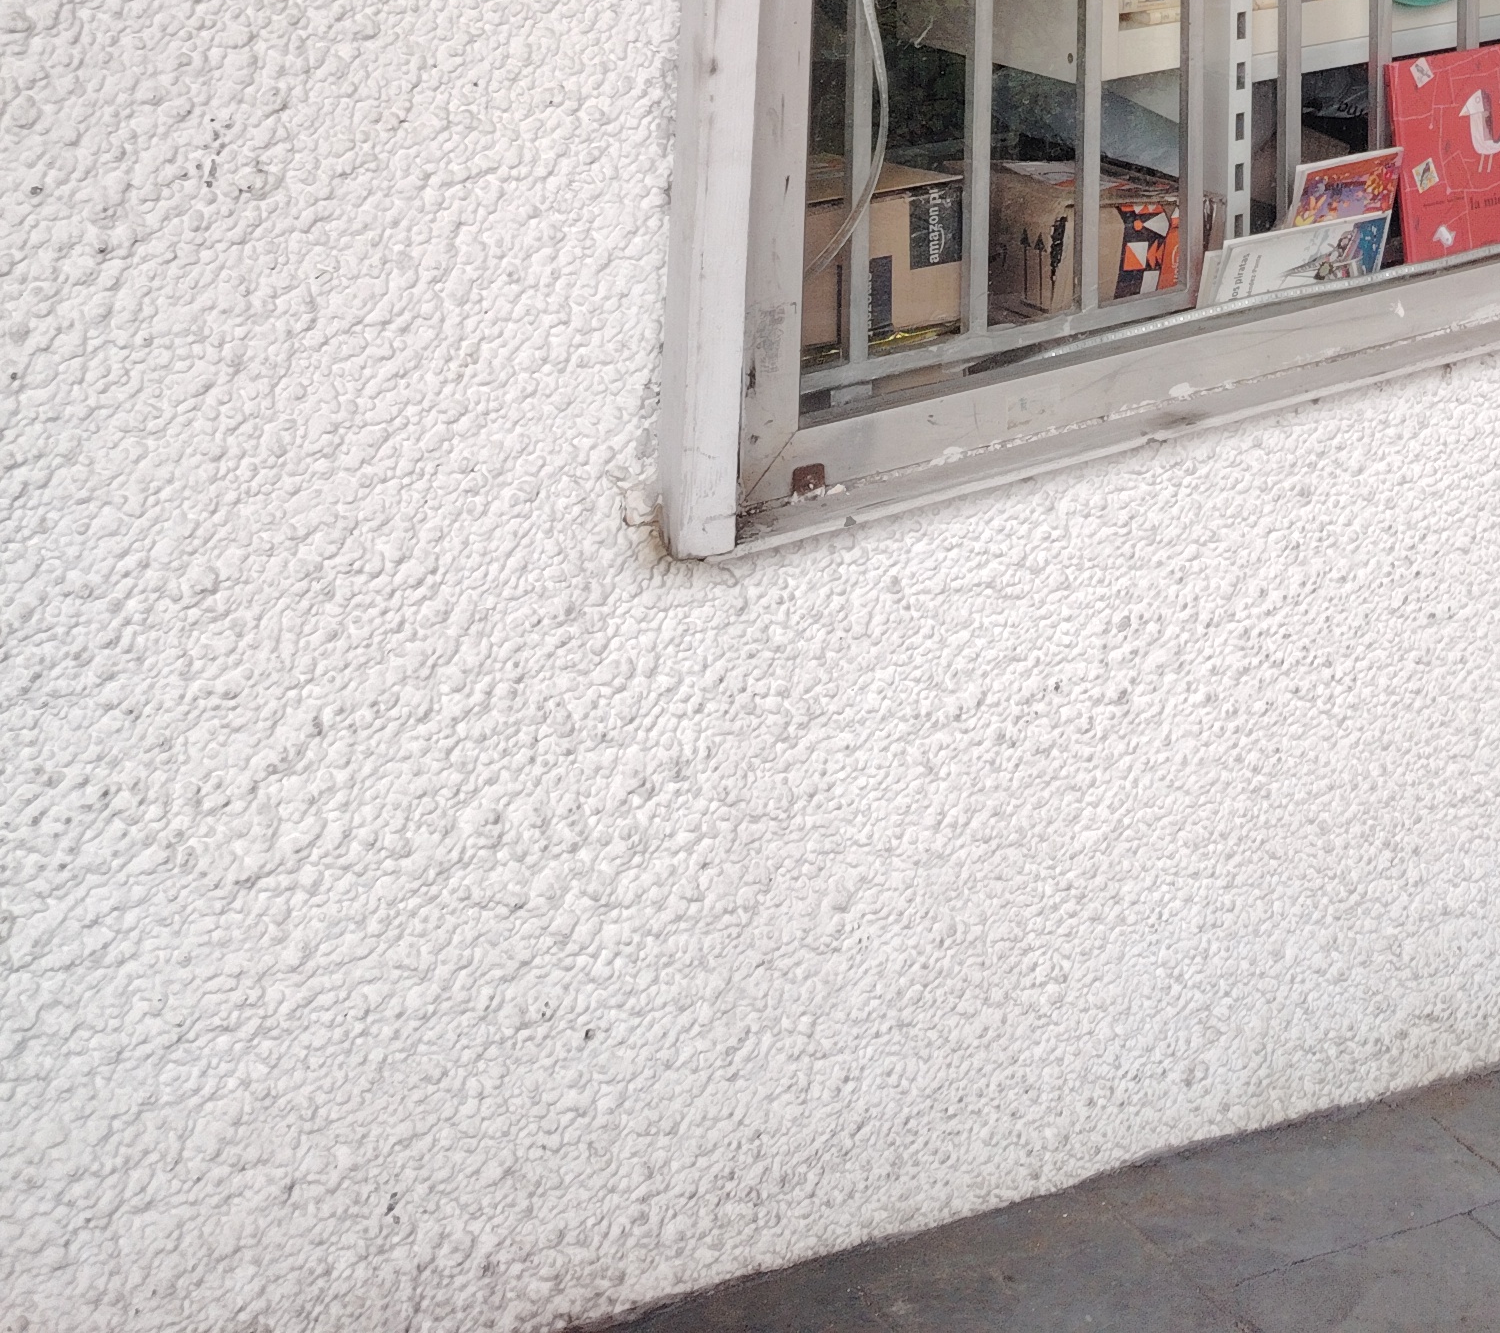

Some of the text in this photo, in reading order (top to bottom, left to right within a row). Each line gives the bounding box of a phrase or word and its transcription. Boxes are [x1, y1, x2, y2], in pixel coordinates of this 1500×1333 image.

[1469, 196, 1481, 211] la
[929, 206, 940, 264] amazon
[1236, 252, 1251, 288] piratas
